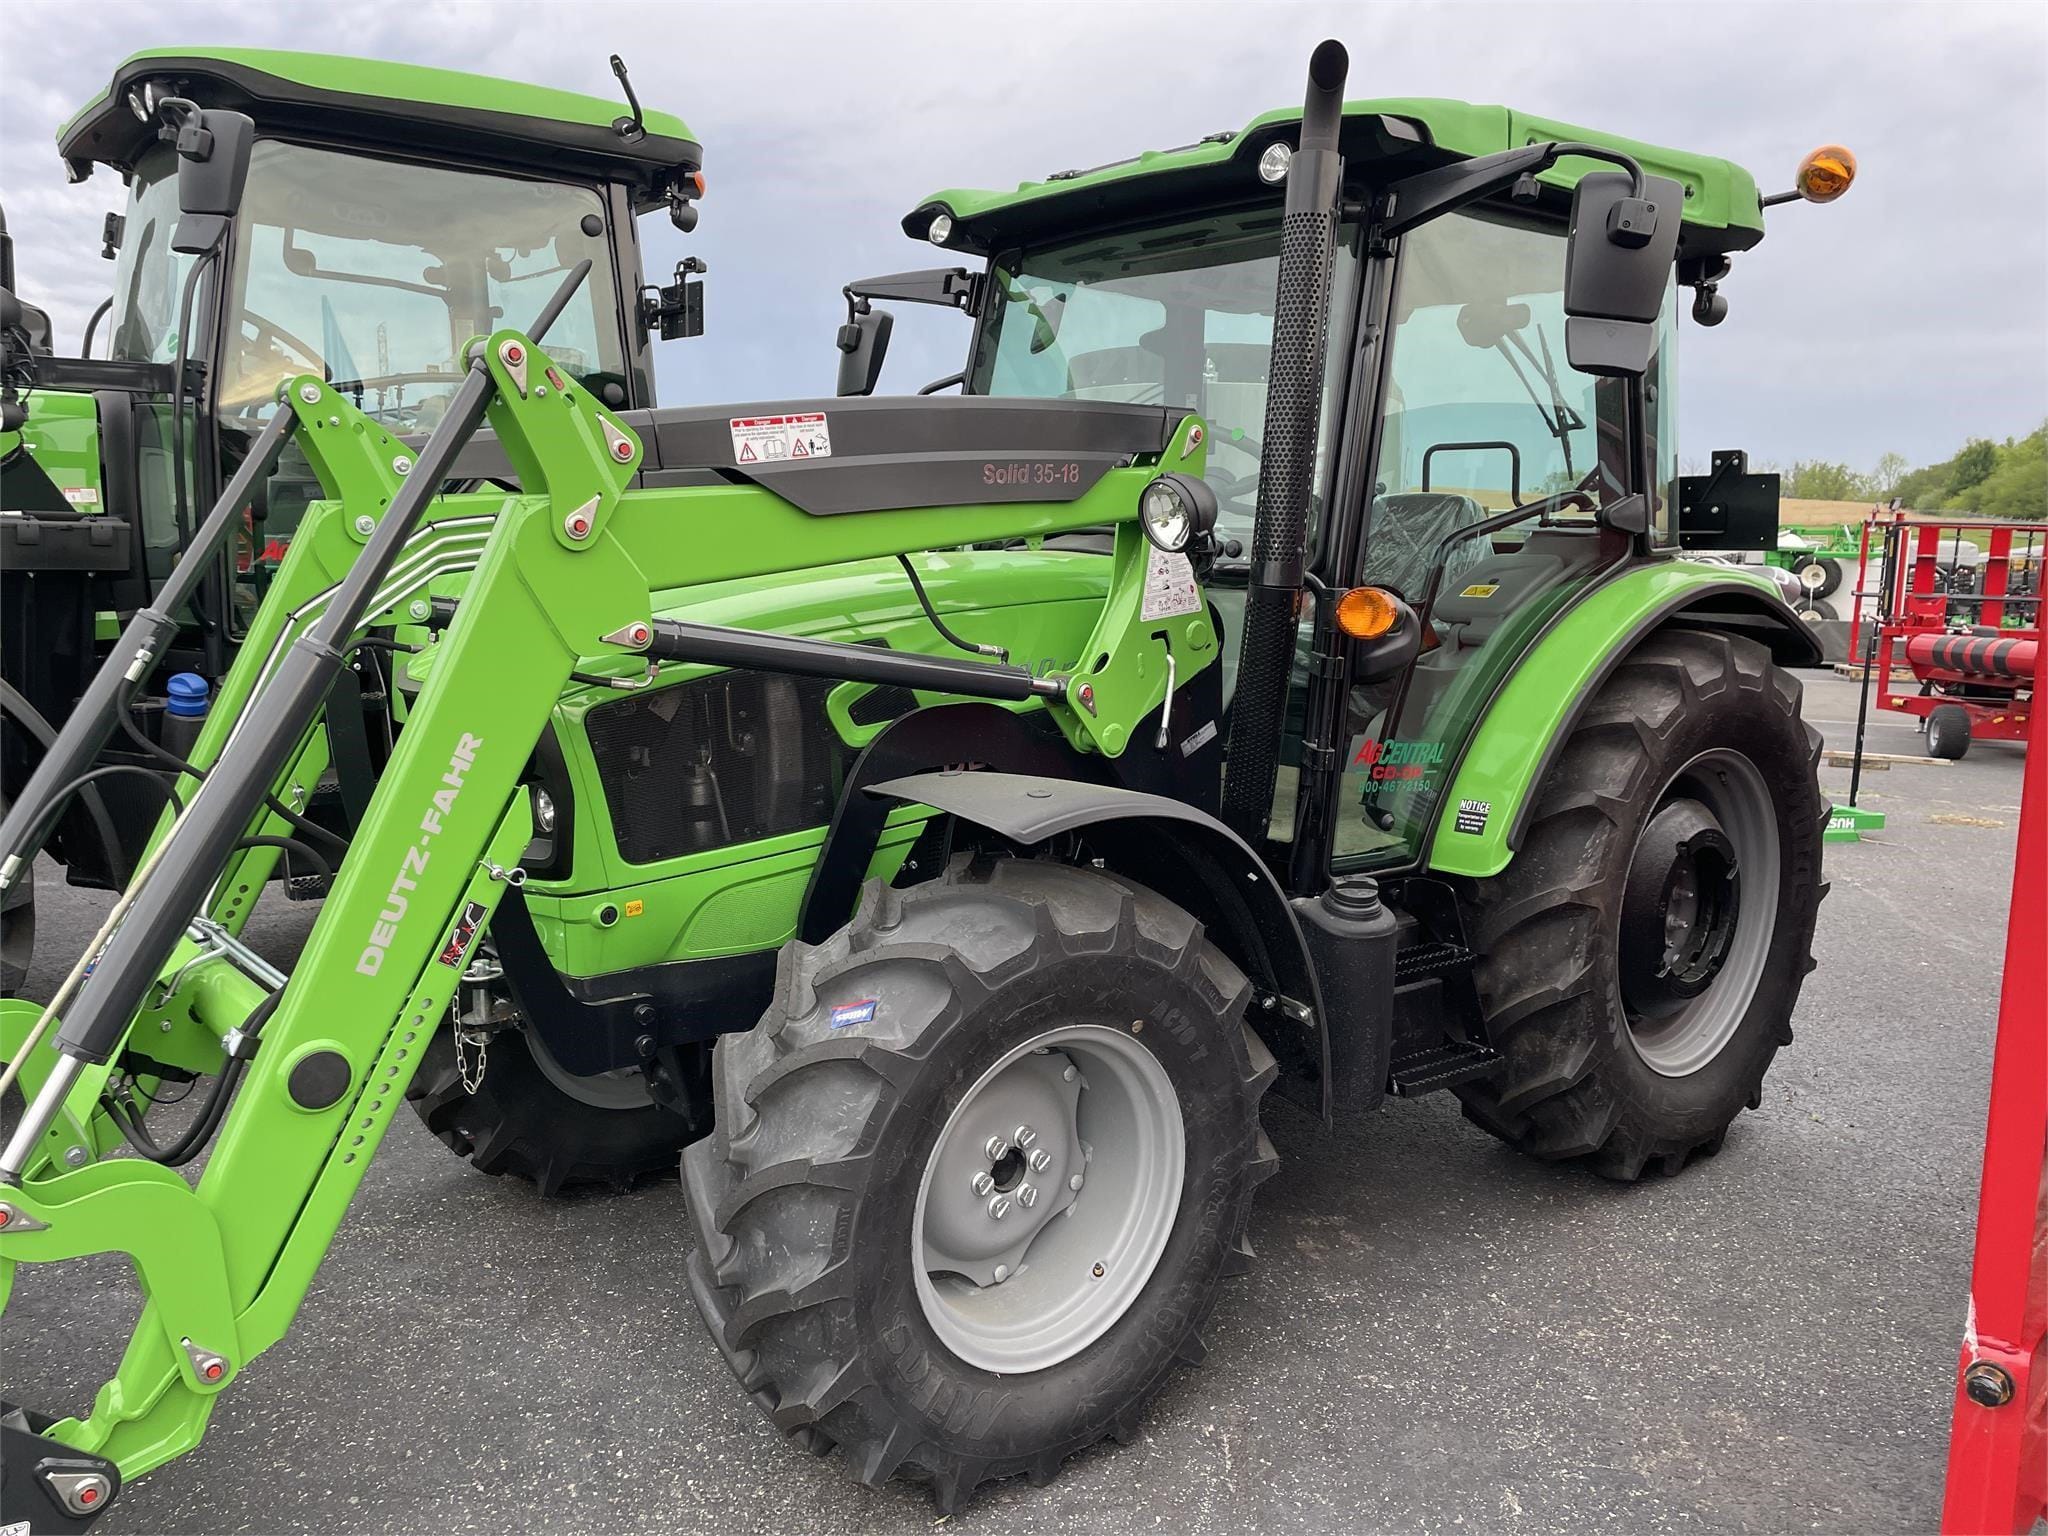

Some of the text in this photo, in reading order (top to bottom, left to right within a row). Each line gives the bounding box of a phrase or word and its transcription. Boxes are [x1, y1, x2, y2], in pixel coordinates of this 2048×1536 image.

[983, 463, 1080, 485] Solid 35-18
[1460, 799, 1491, 812] NOTICE
[1826, 817, 1855, 829] HUS
[355, 732, 484, 977] DEUTZ-FAHR
